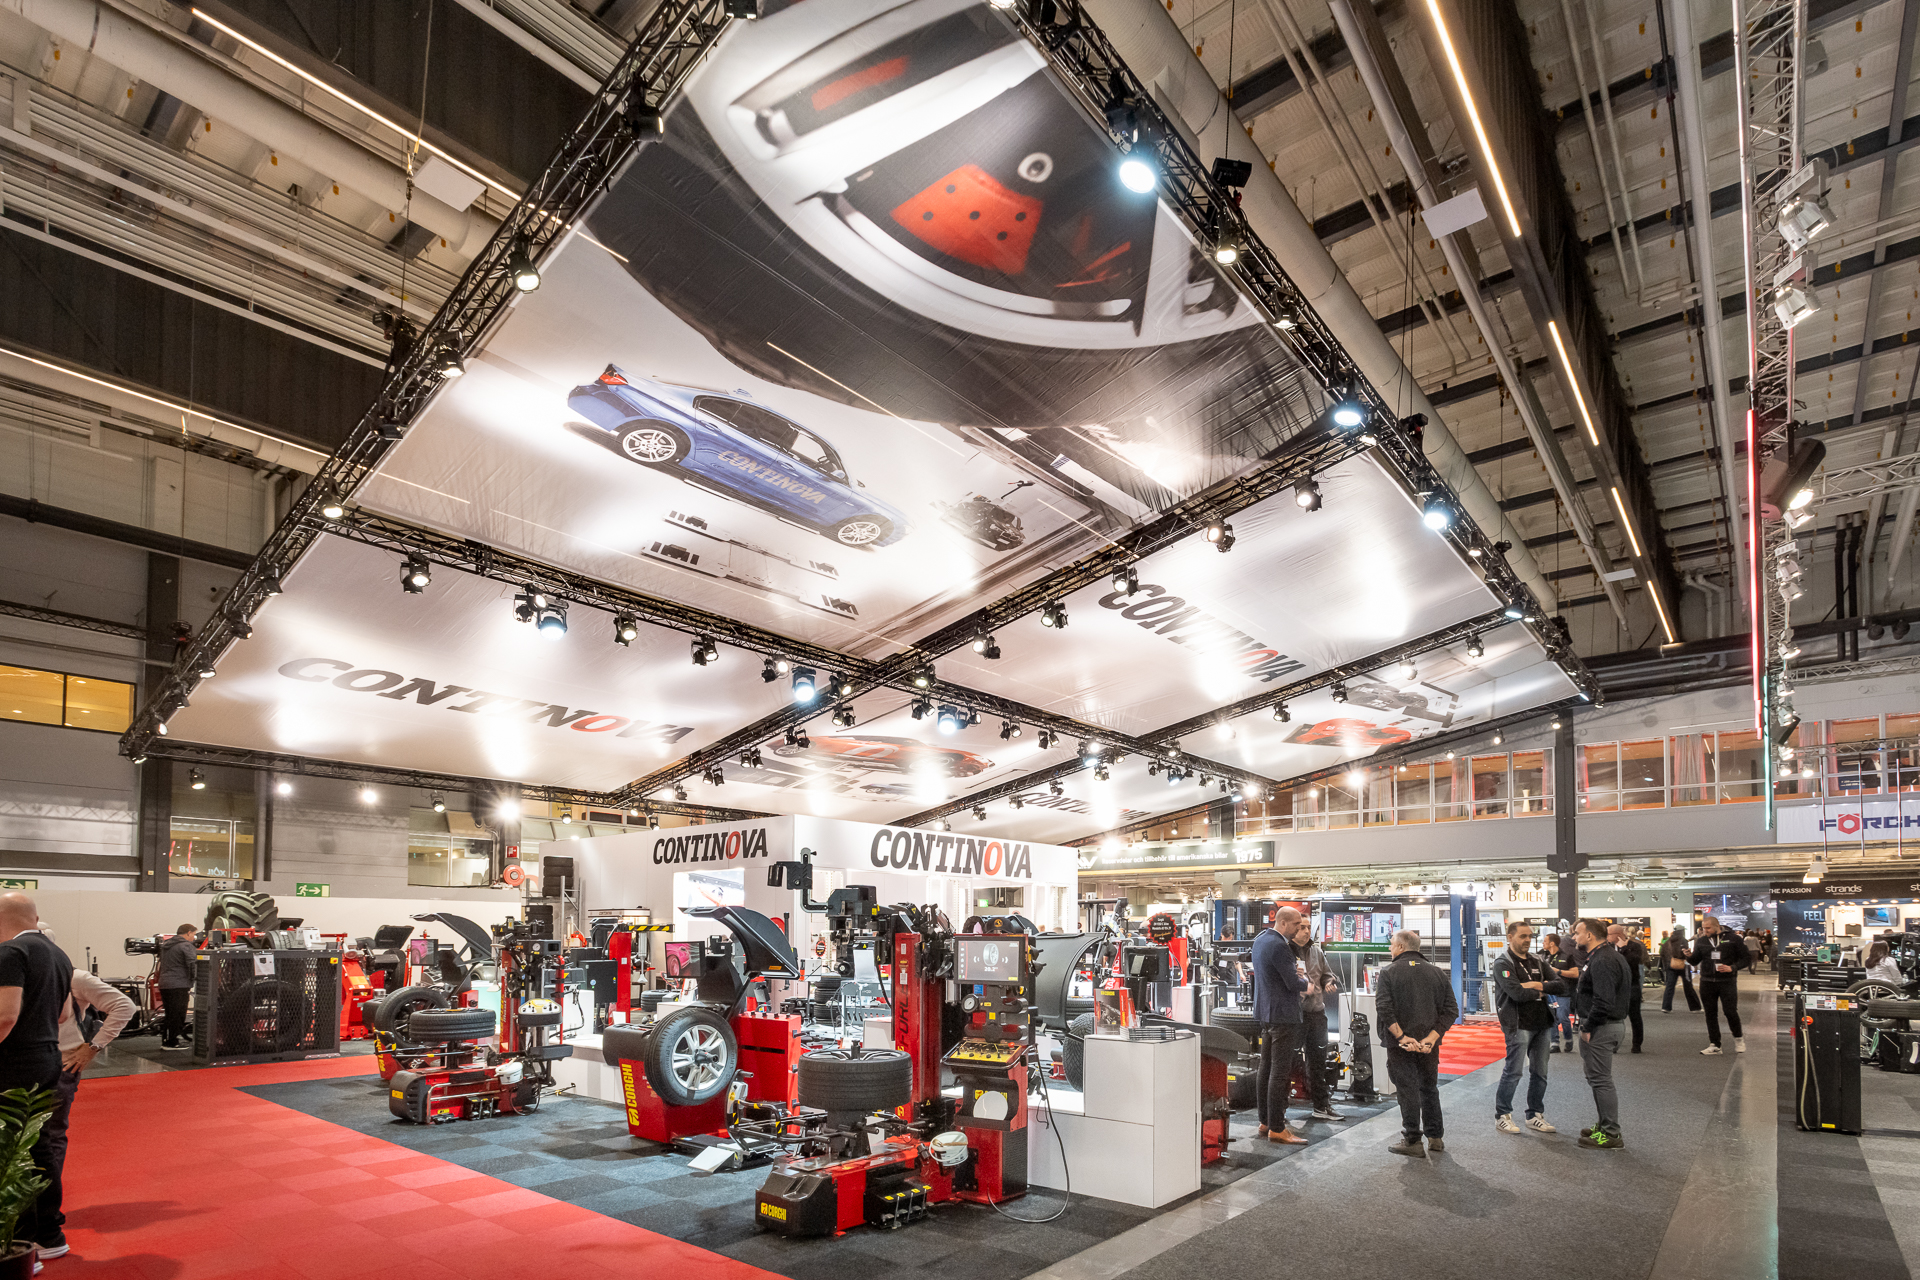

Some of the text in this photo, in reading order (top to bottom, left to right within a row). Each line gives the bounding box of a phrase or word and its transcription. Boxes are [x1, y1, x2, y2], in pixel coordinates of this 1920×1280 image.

[717, 450, 827, 504] CONTINOVA
[653, 828, 769, 865] CONTINOVA
[870, 828, 1033, 879] CONTINOVA
[1176, 853, 1214, 861] amerikanska
[1234, 849, 1263, 863] 1975
[1508, 889, 1543, 902] BOIER
[1825, 885, 1862, 893] strands
[1803, 910, 1825, 921] FEEL
[621, 1063, 638, 1108] CORGHI
[768, 1204, 787, 1221] CORGHI
